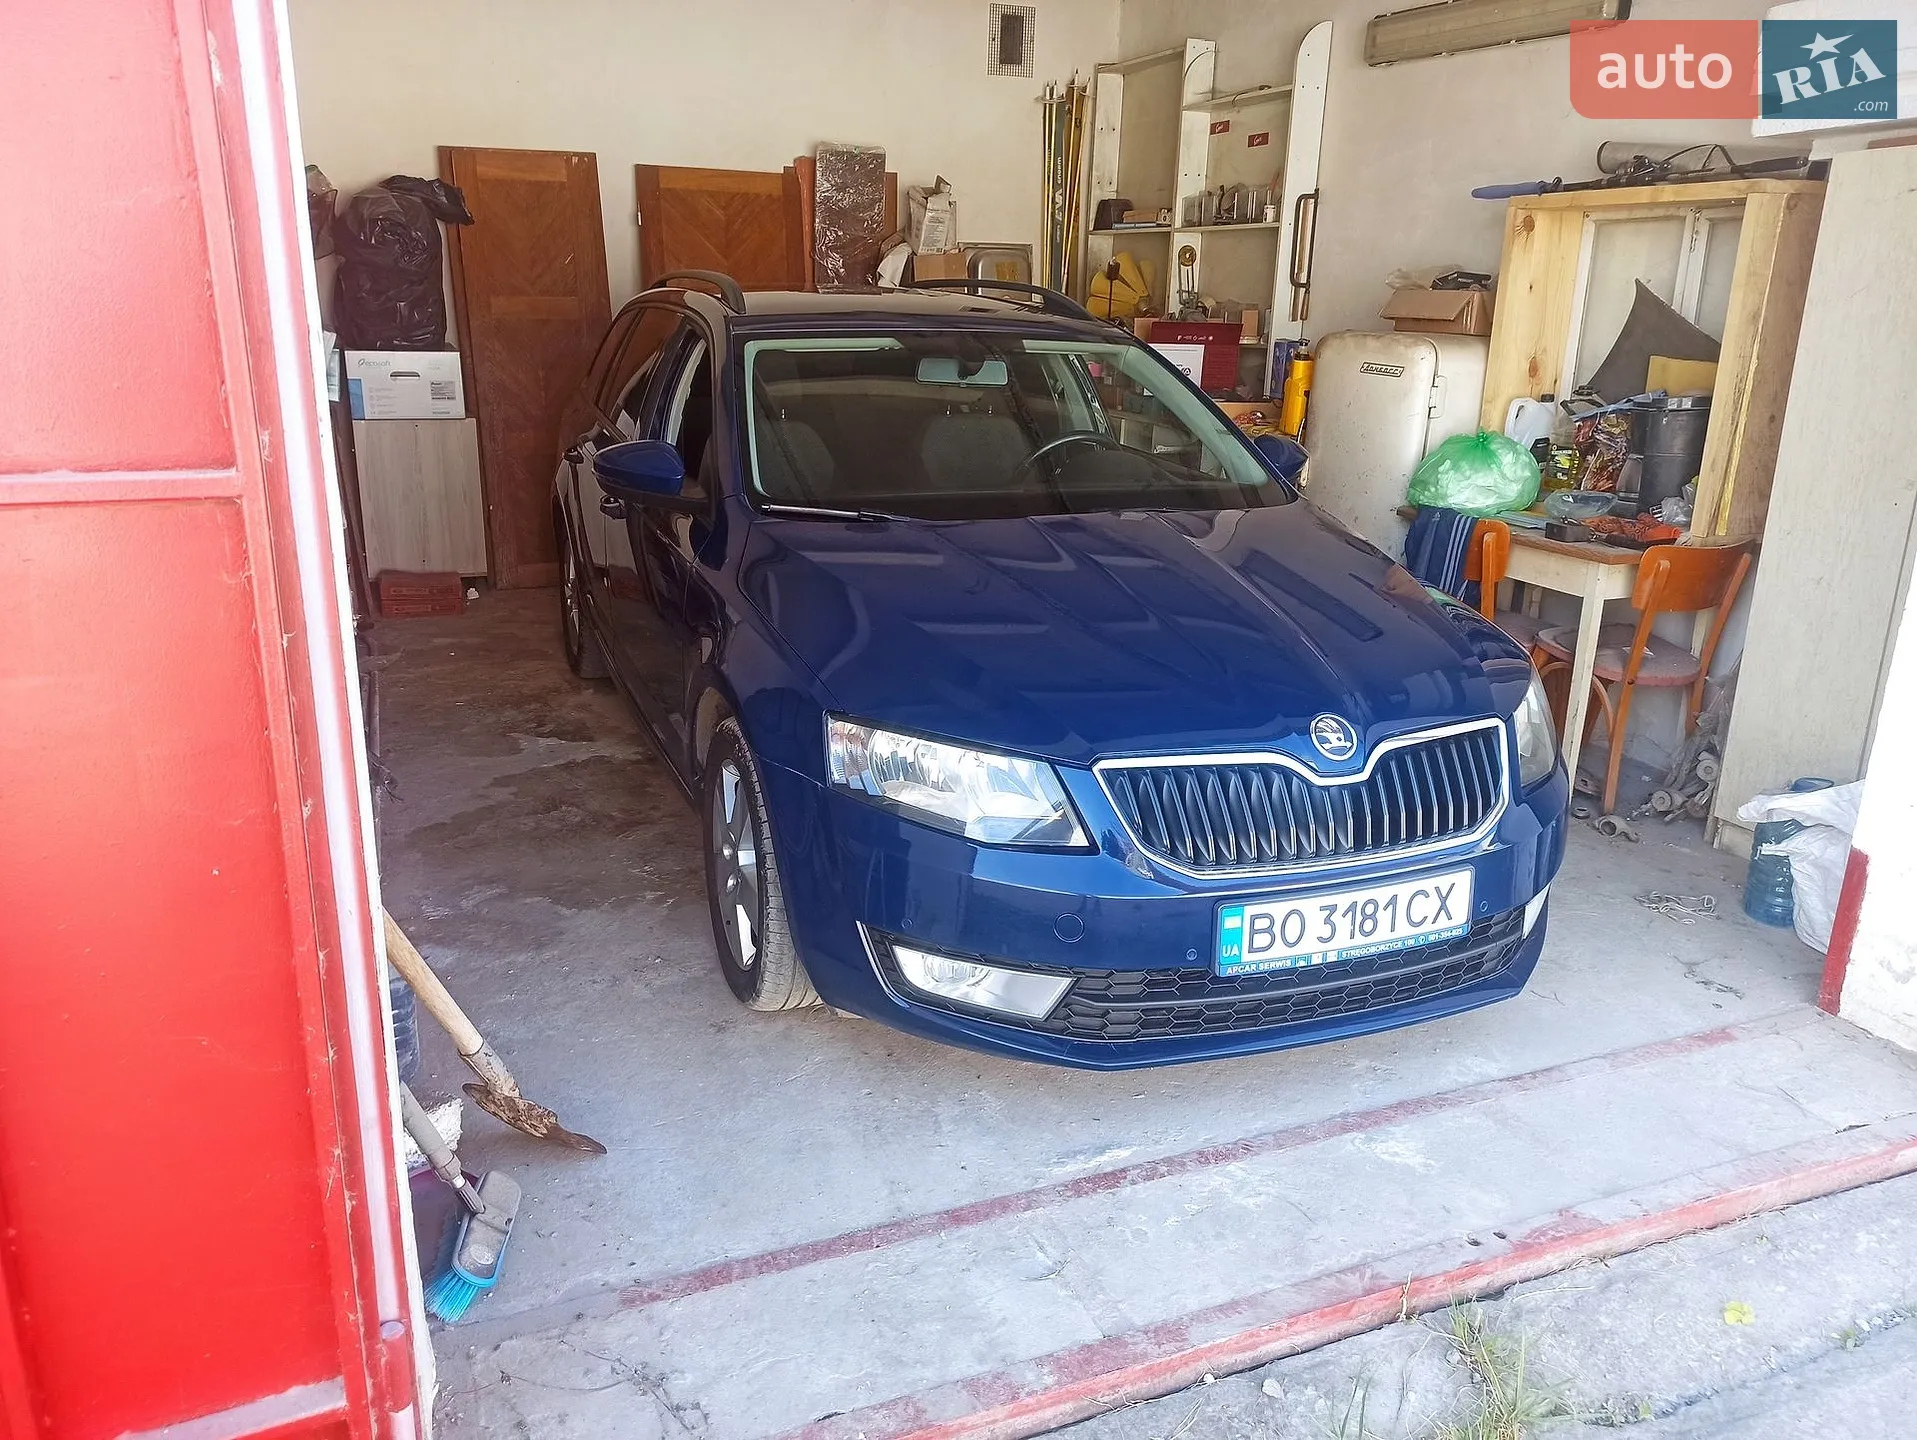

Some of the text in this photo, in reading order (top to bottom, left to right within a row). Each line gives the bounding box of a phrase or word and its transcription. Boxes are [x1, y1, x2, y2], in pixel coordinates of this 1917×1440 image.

[1248, 883, 1455, 954] BO 3181 CX
[1222, 944, 1240, 958] UA
[1258, 959, 1292, 972] SERWIS
